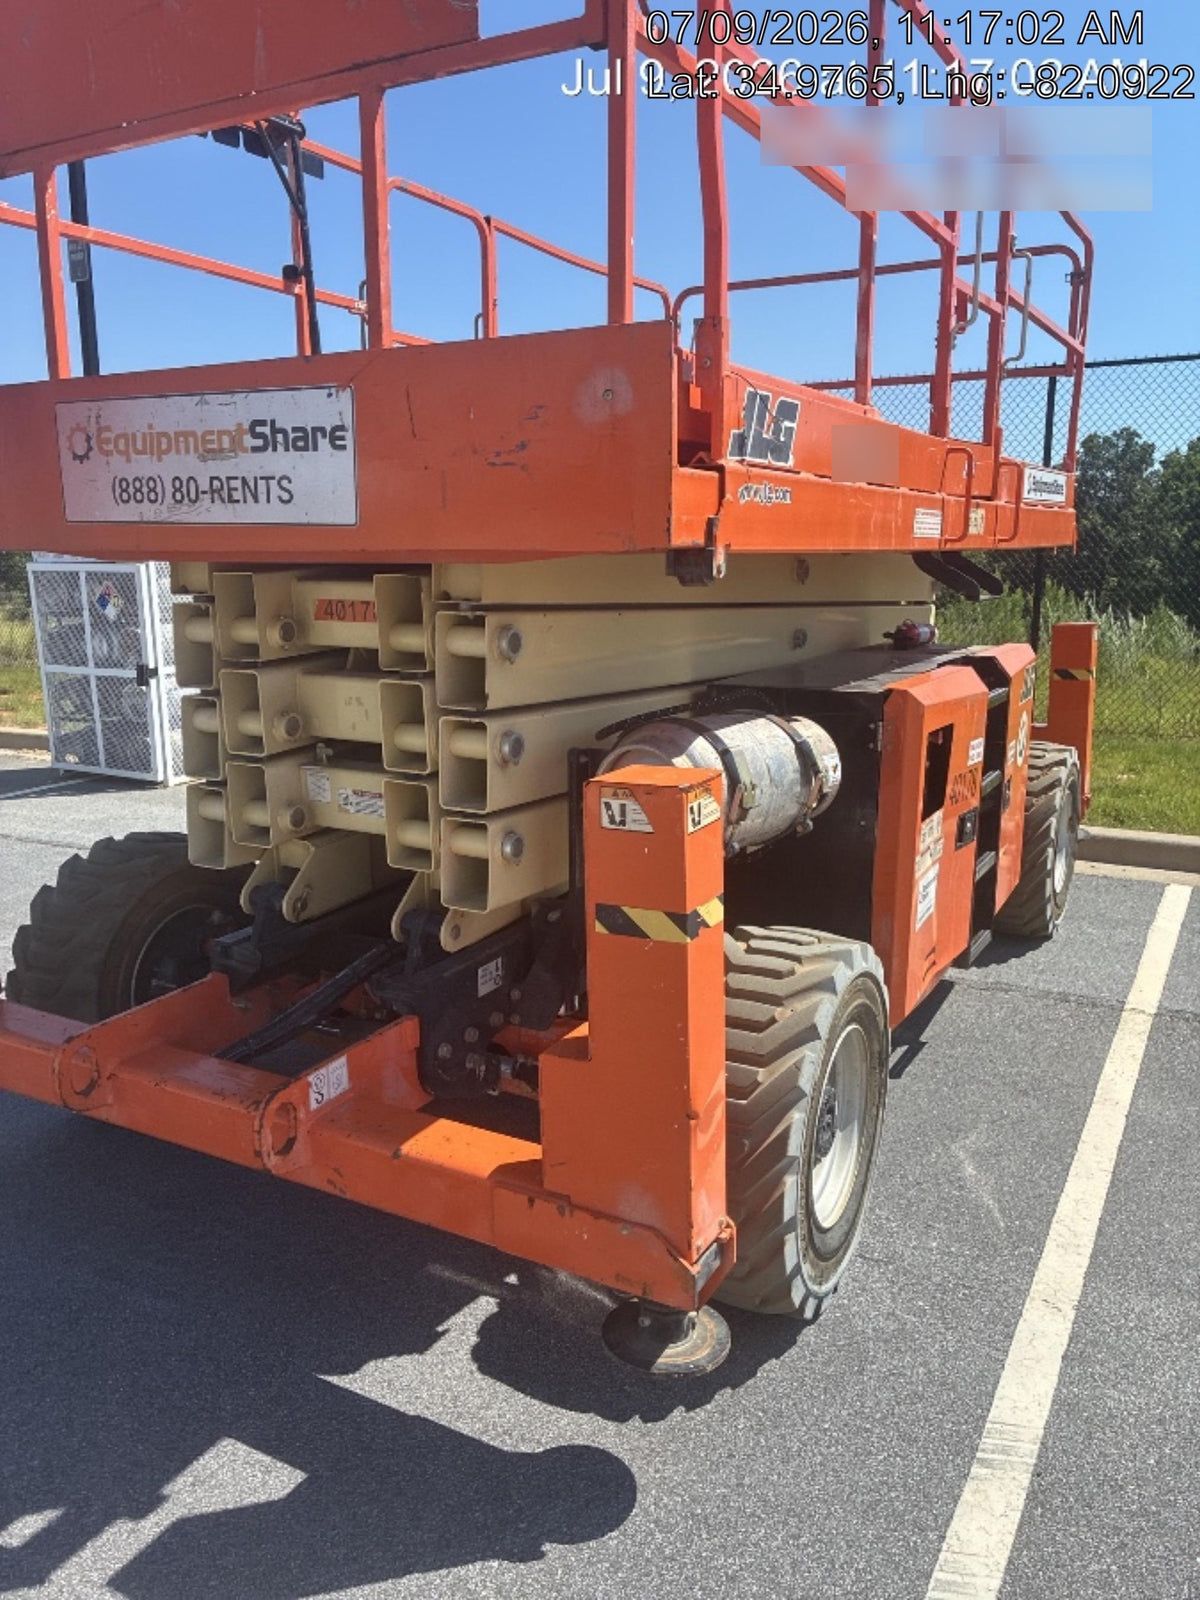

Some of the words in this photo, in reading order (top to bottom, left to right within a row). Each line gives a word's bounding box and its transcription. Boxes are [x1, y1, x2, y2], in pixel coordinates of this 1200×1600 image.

[96, 419, 347, 463] EquipmentShare
[727, 386, 801, 466] JLG
[112, 475, 165, 507] (888)
[171, 475, 294, 506] 80-RENTS
[323, 600, 377, 622] 4017
